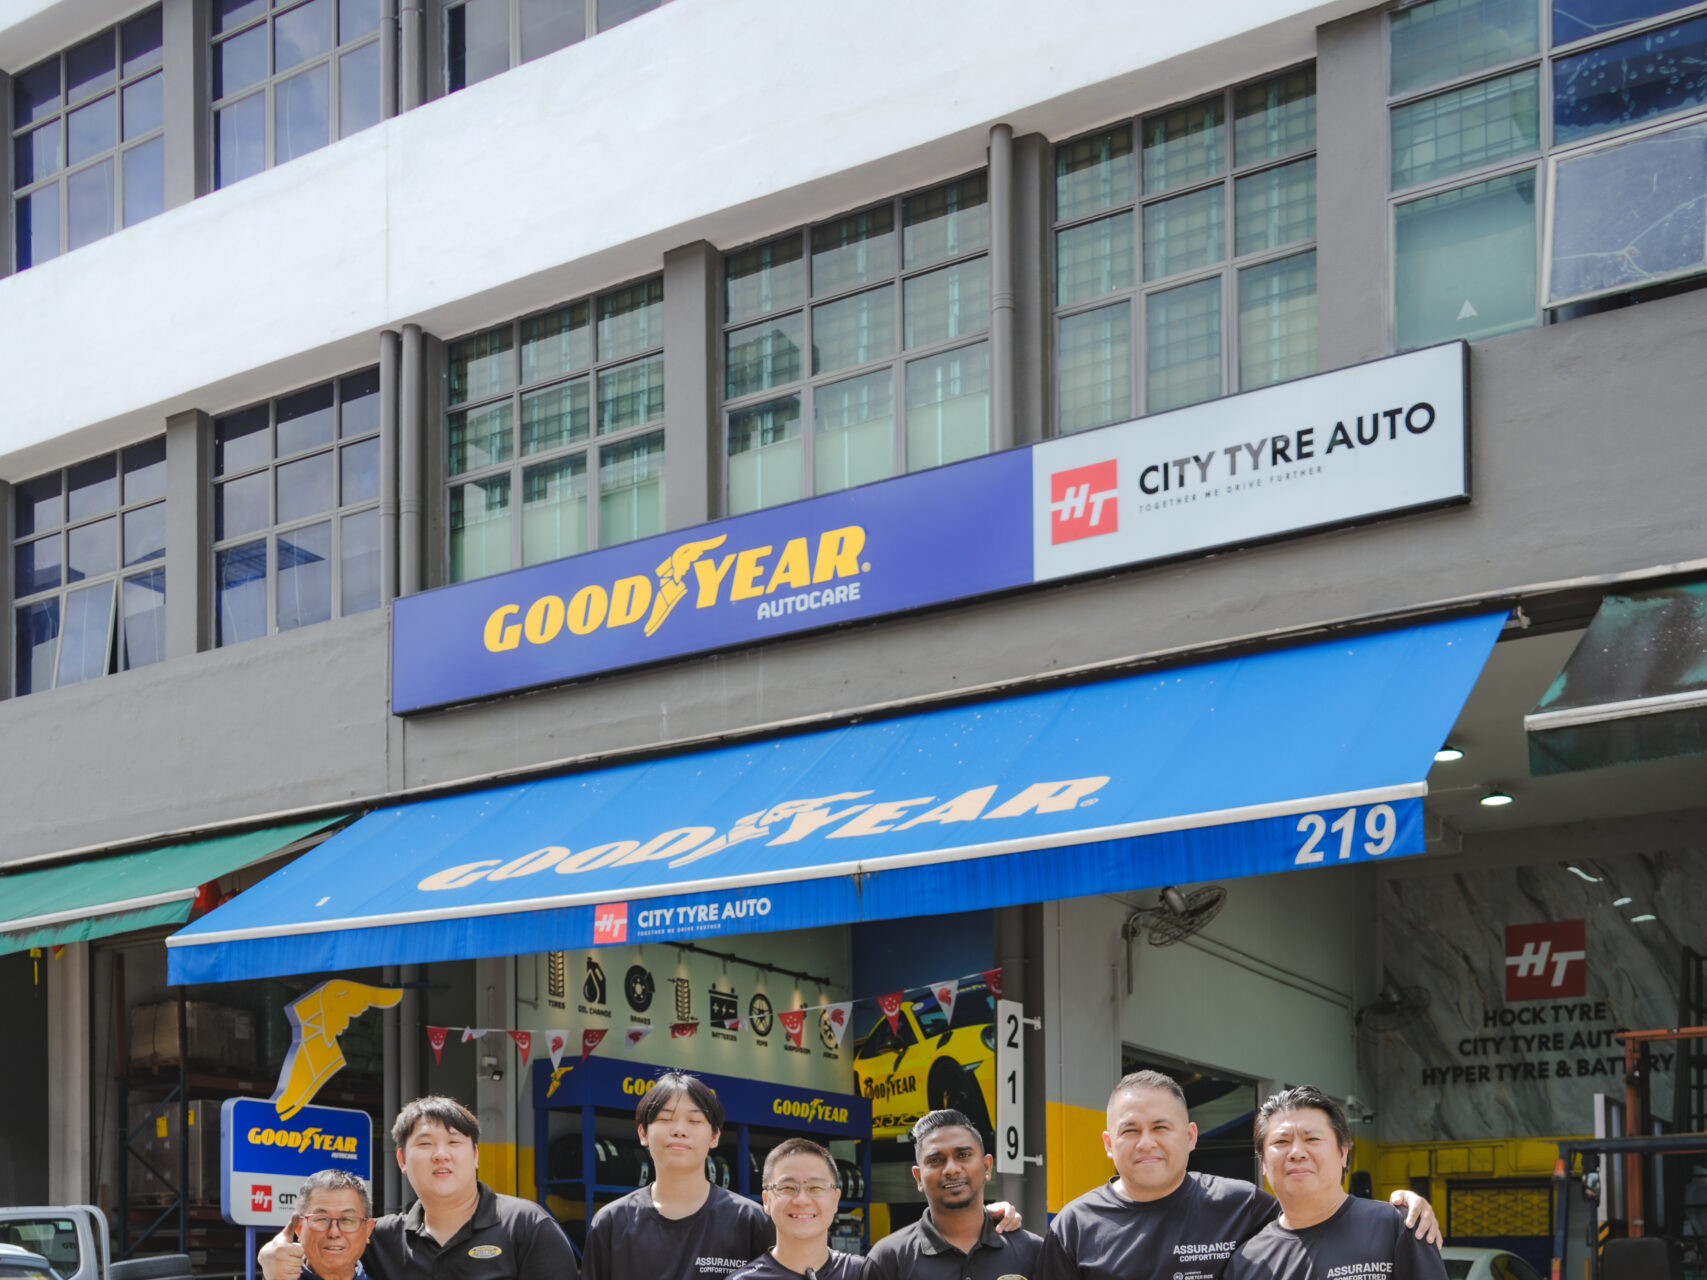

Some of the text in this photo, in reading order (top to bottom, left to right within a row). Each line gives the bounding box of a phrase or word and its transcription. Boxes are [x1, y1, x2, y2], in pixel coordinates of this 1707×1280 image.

[1139, 402, 1436, 496] CITY TYRE AUTO
[1139, 493, 1197, 513] TOGETHER
[1226, 478, 1262, 494] DRIVE
[1269, 466, 1322, 484] FURTHER
[1050, 482, 1118, 528] HT
[483, 525, 867, 653] GOODYEAR
[757, 582, 861, 621] AUTOCARE
[418, 776, 1110, 892] GOODYEAR
[1294, 804, 1397, 865] 219
[594, 913, 627, 937] HT
[637, 897, 772, 928] CITY TYRE AUTO
[1505, 941, 1585, 987] HT
[548, 1000, 565, 1009] TIRES
[589, 1007, 612, 1018] CHANGE
[1484, 1002, 1606, 1028] HOCK TYRE
[1459, 1036, 1506, 1056] CITY
[1510, 1033, 1564, 1054] TYRE
[1422, 1054, 1675, 1087] HYPER TYRE & BATTRY
[773, 1098, 849, 1123] GOODYEAR
[248, 1127, 358, 1154] GOODYEAR
[251, 1190, 272, 1208] HT
[1173, 1241, 1237, 1255] ASSURANCE
[1180, 1252, 1231, 1262] COMFORTTRED
[695, 1257, 748, 1268] ASSURANCE
[1327, 1262, 1393, 1278] ASSURANCE
